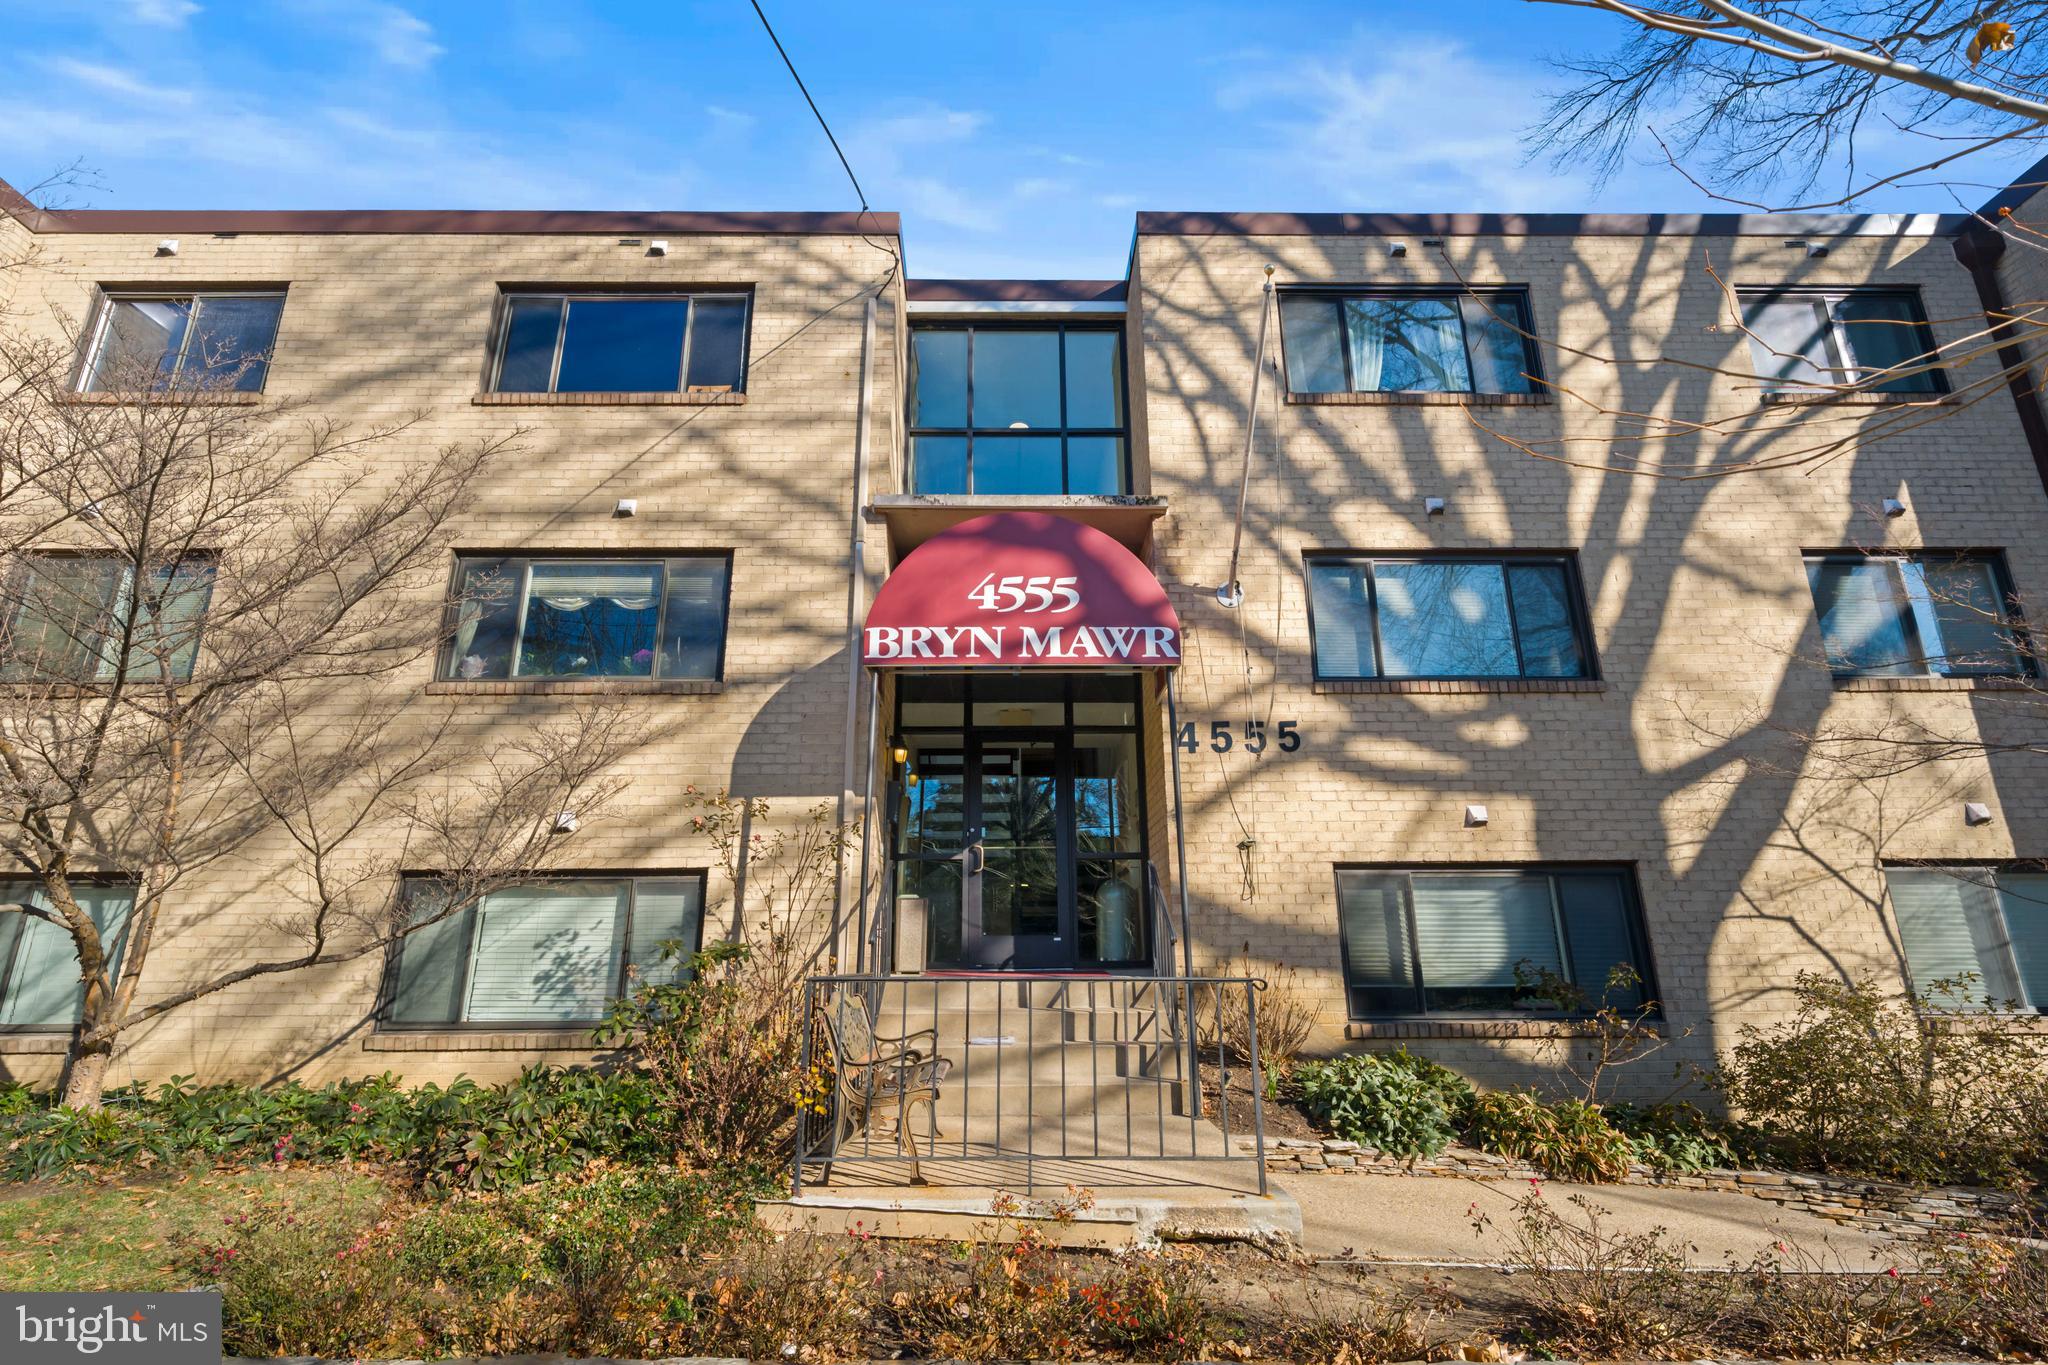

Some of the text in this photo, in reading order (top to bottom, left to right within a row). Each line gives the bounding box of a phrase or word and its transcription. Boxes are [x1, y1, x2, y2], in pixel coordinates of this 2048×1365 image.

[968, 573, 1080, 613] 4555
[864, 626, 1180, 659] BRYN MAWR
[1177, 720, 1301, 754] 4555
